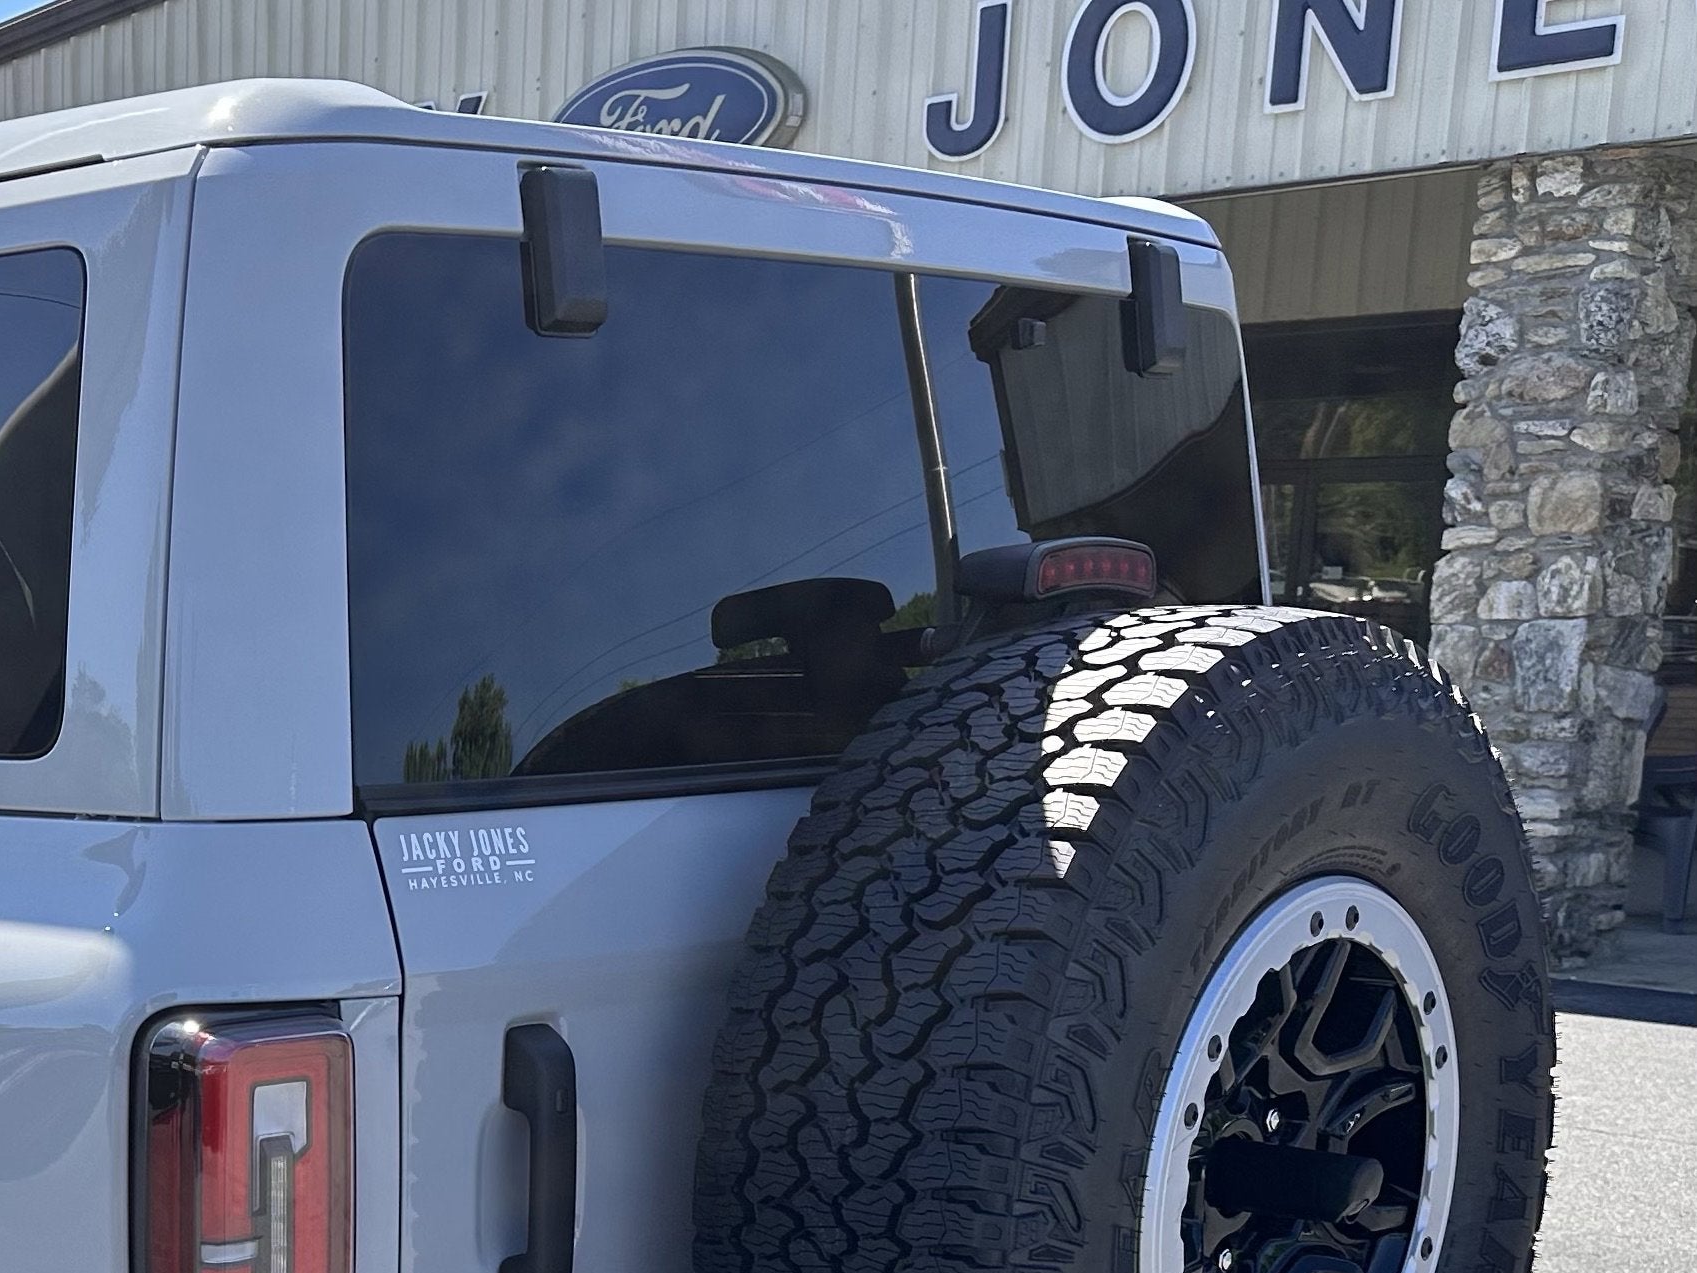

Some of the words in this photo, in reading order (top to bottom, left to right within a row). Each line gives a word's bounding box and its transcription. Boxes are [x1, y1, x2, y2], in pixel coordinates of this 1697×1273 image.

[399, 830, 461, 862] JACKY
[469, 826, 530, 858] JONES
[436, 855, 501, 875] FORD
[408, 871, 507, 891] HAYESVILLE,
[513, 869, 534, 883] NC
